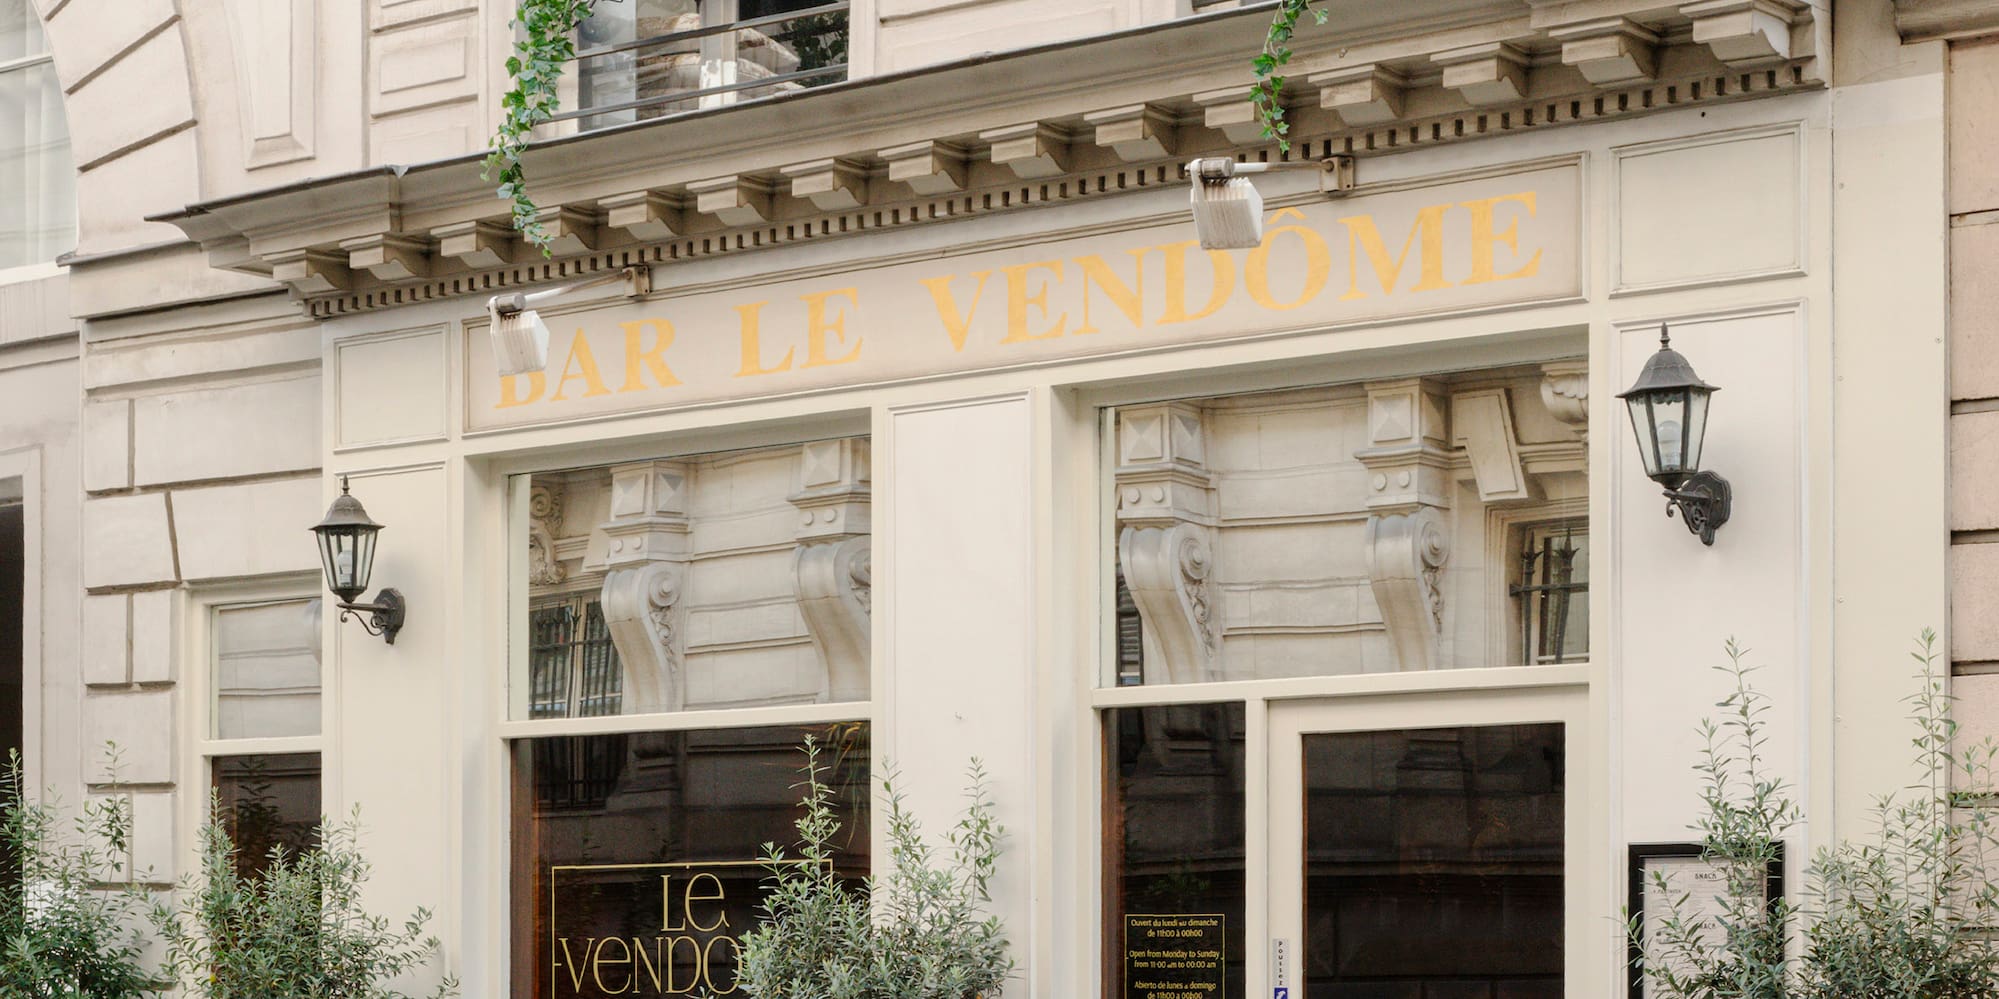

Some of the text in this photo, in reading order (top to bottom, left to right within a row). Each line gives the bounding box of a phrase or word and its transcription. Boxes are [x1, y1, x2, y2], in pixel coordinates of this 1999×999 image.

[732, 287, 863, 377] LE
[918, 191, 1543, 353] VENDÔME
[1131, 919, 1152, 927] Ouvert
[1153, 919, 1161, 927] du
[1162, 919, 1178, 927] lundi
[1188, 918, 1218, 927] dimanche
[1147, 929, 1156, 938] de
[1157, 929, 1175, 937] 11h00
[1181, 929, 1203, 937] 00h00
[1129, 949, 1220, 960] Open from Monday to Sunday
[1134, 960, 1149, 968] from
[1134, 980, 1157, 989] Abierto
[1157, 981, 1166, 989] de
[1166, 981, 1183, 989] lunes
[1189, 981, 1216, 992] domingo
[1147, 991, 1155, 999] de
